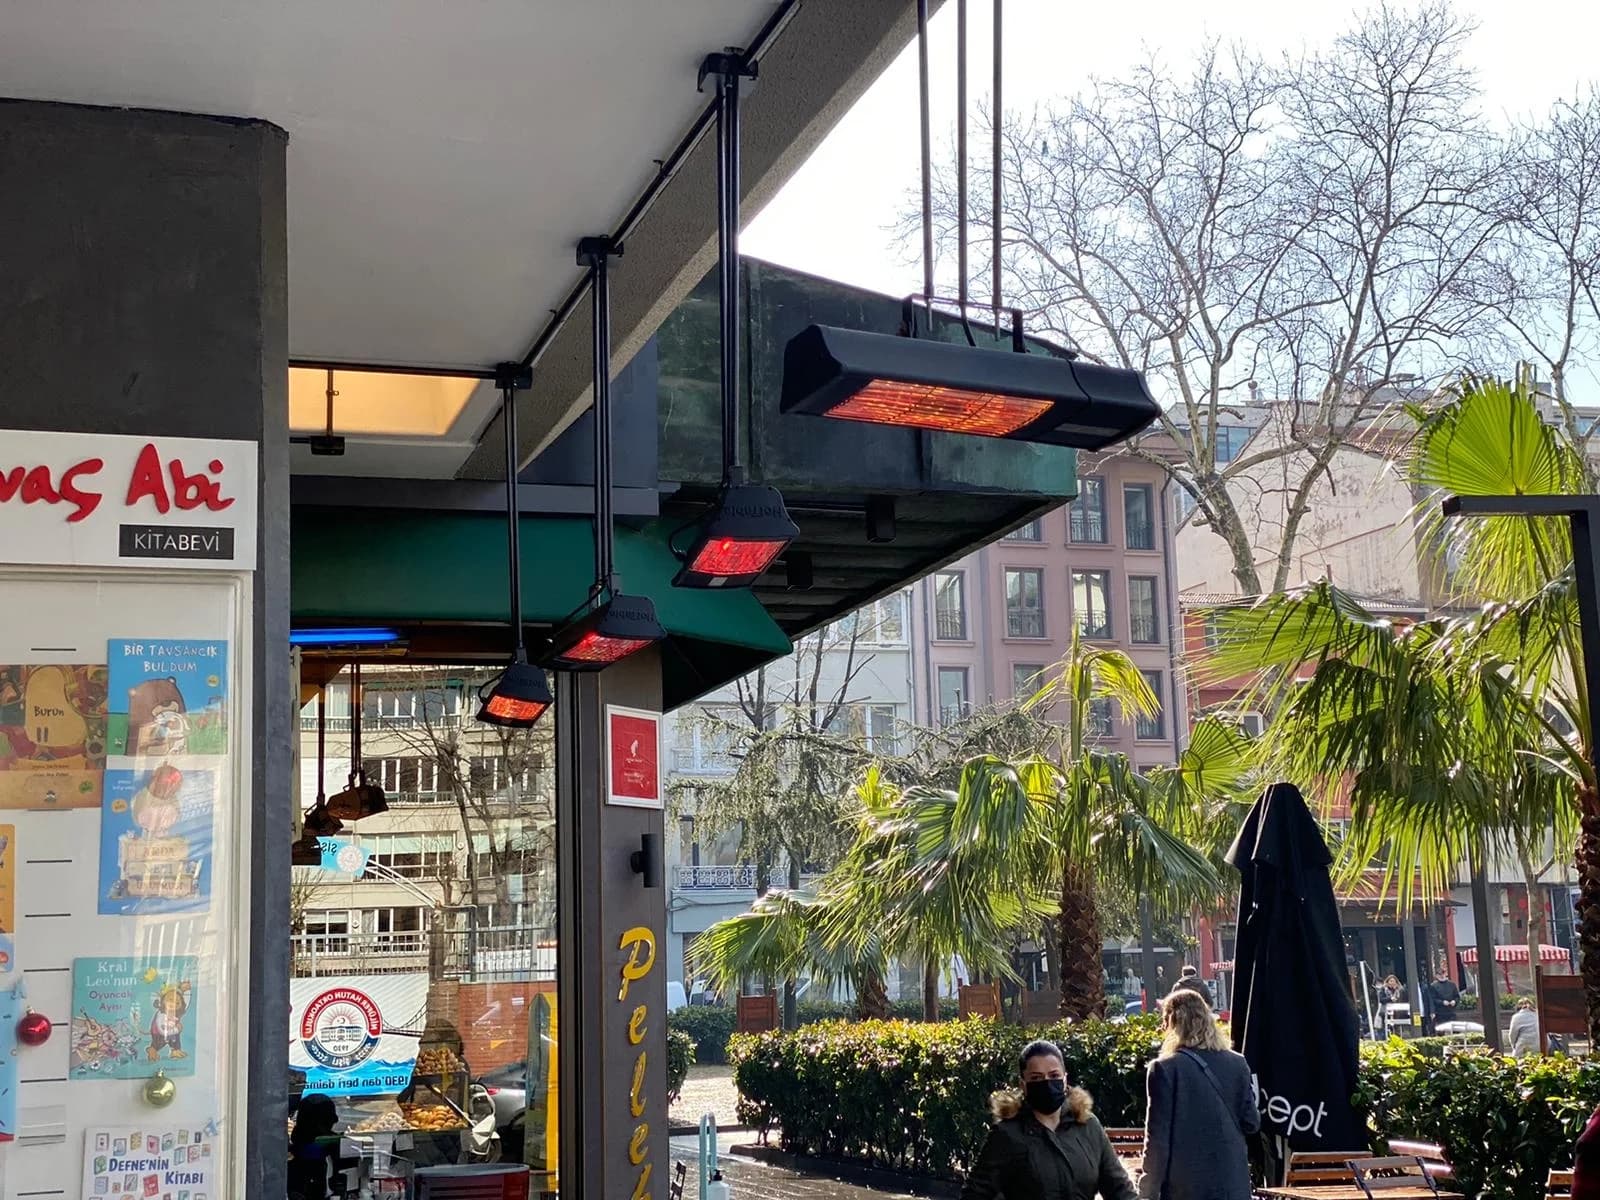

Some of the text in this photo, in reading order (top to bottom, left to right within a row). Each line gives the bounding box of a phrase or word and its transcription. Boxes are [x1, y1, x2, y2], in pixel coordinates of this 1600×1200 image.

[125, 443, 235, 514] Abi
[134, 529, 220, 551] KİTABEVİ
[124, 645, 143, 656] BİR
[143, 661, 197, 672] BULDUM
[34, 706, 64, 716] Burun
[97, 962, 127, 973] Kral
[86, 975, 136, 986] Leo'nun
[109, 1156, 169, 1172] DEFNE'NİN
[165, 1171, 204, 1185] KİTABI
